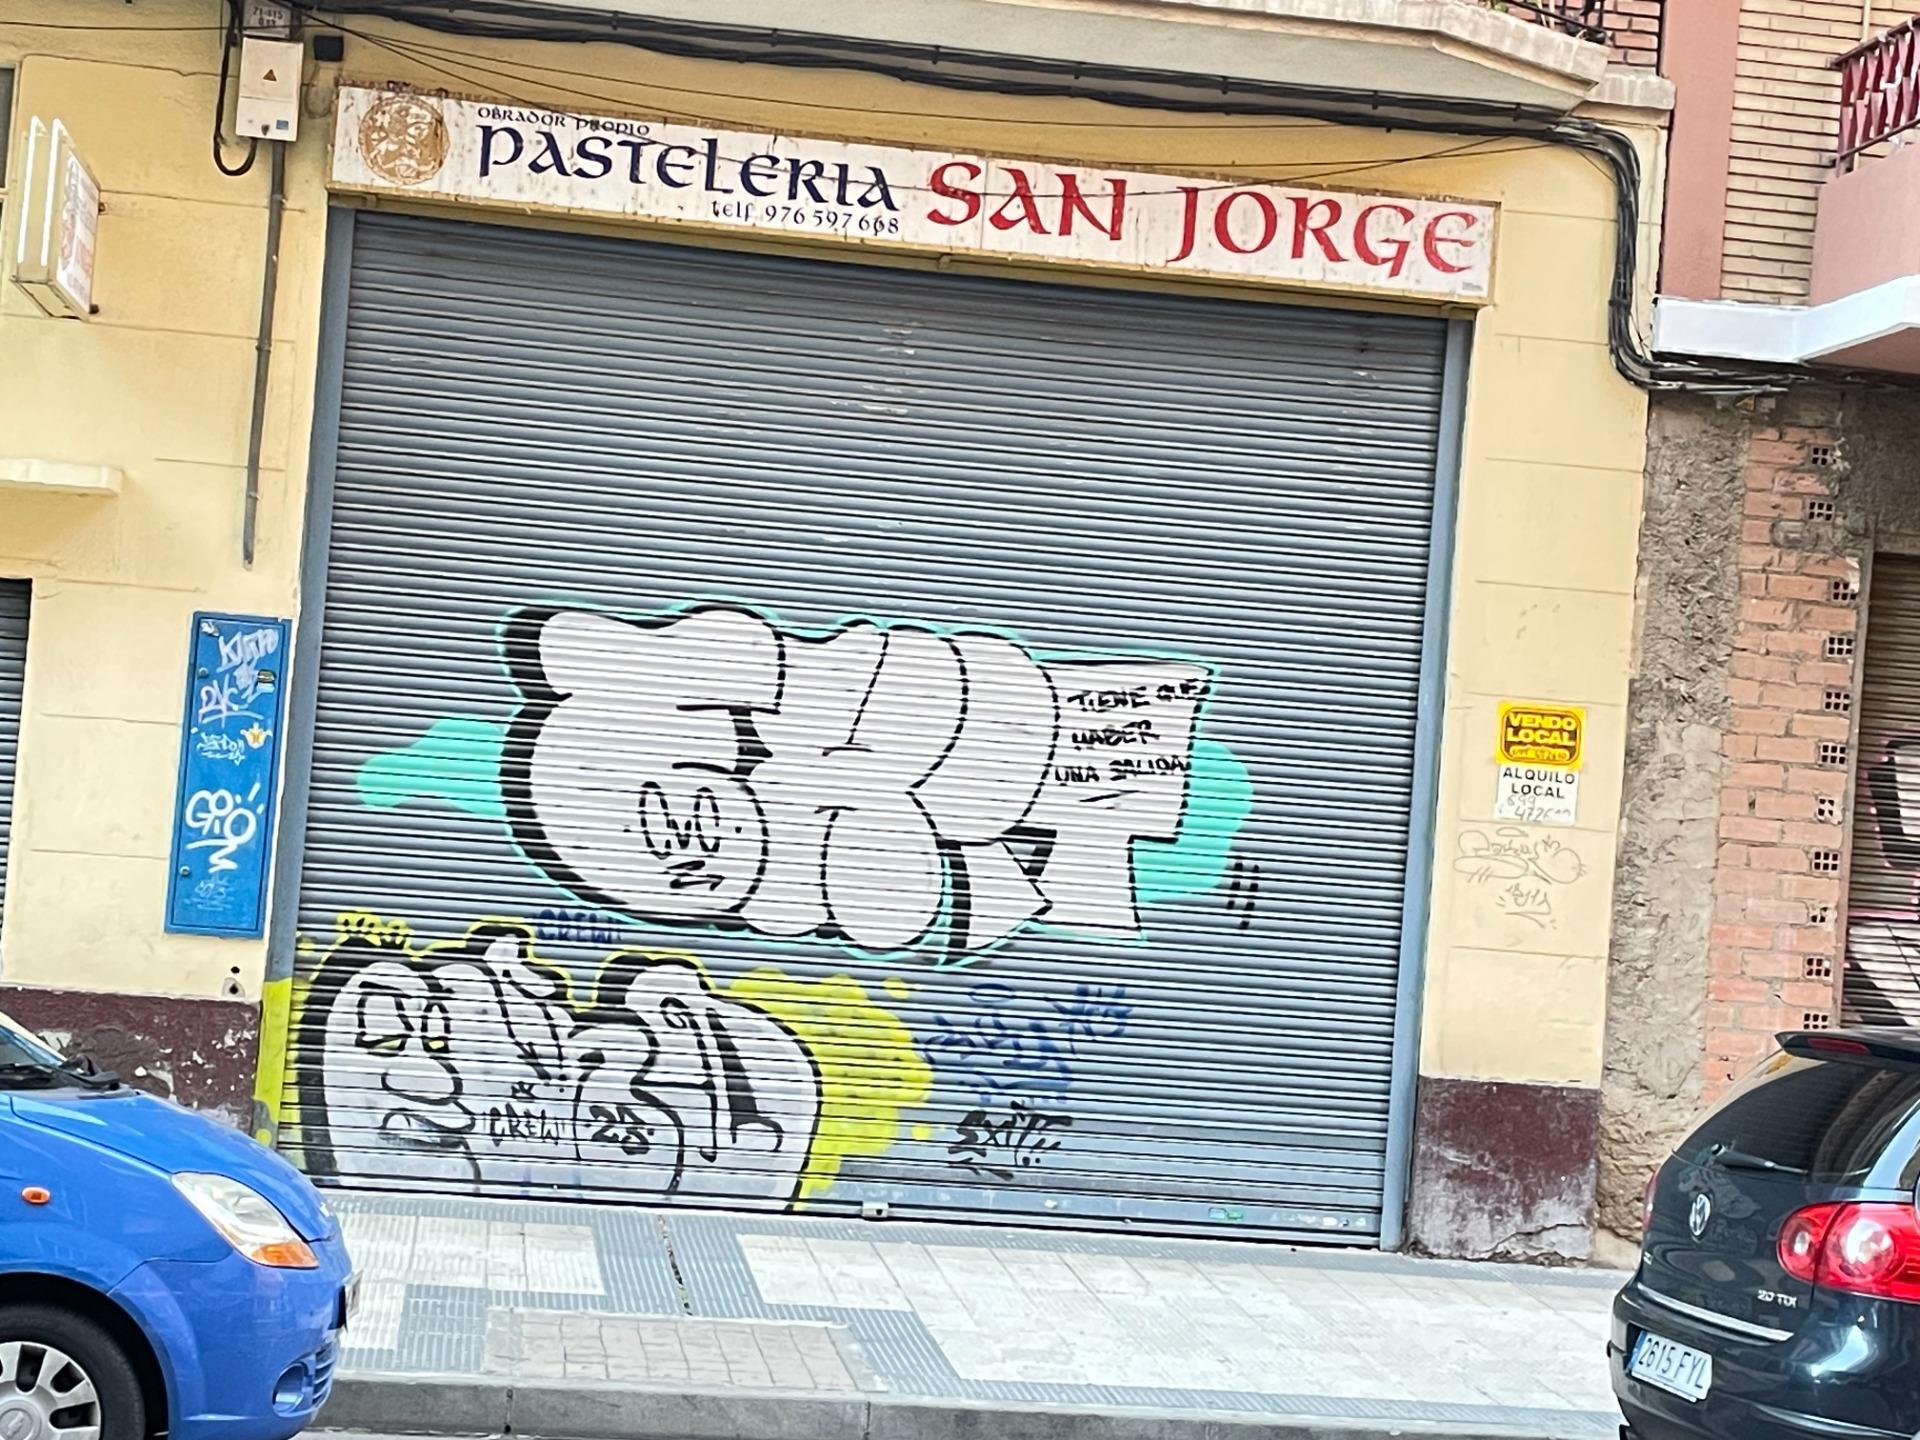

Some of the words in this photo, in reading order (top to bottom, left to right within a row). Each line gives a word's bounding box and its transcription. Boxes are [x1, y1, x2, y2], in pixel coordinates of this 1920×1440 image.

[477, 106, 566, 128] OBRADOR
[475, 124, 900, 211] PASTELERIA
[926, 161, 1128, 241] SAN
[1166, 186, 1479, 279] JORGE
[764, 205, 806, 225] 976
[812, 209, 853, 230] 597
[1508, 712, 1577, 731] VENDO
[1506, 727, 1576, 747] LOCAL
[1503, 766, 1576, 785] ALQUILO
[1511, 783, 1566, 799] LOCAL
[1776, 1293, 1797, 1308] TDI
[1638, 1337, 1677, 1374] 2615
[1673, 1351, 1708, 1390] FYL
